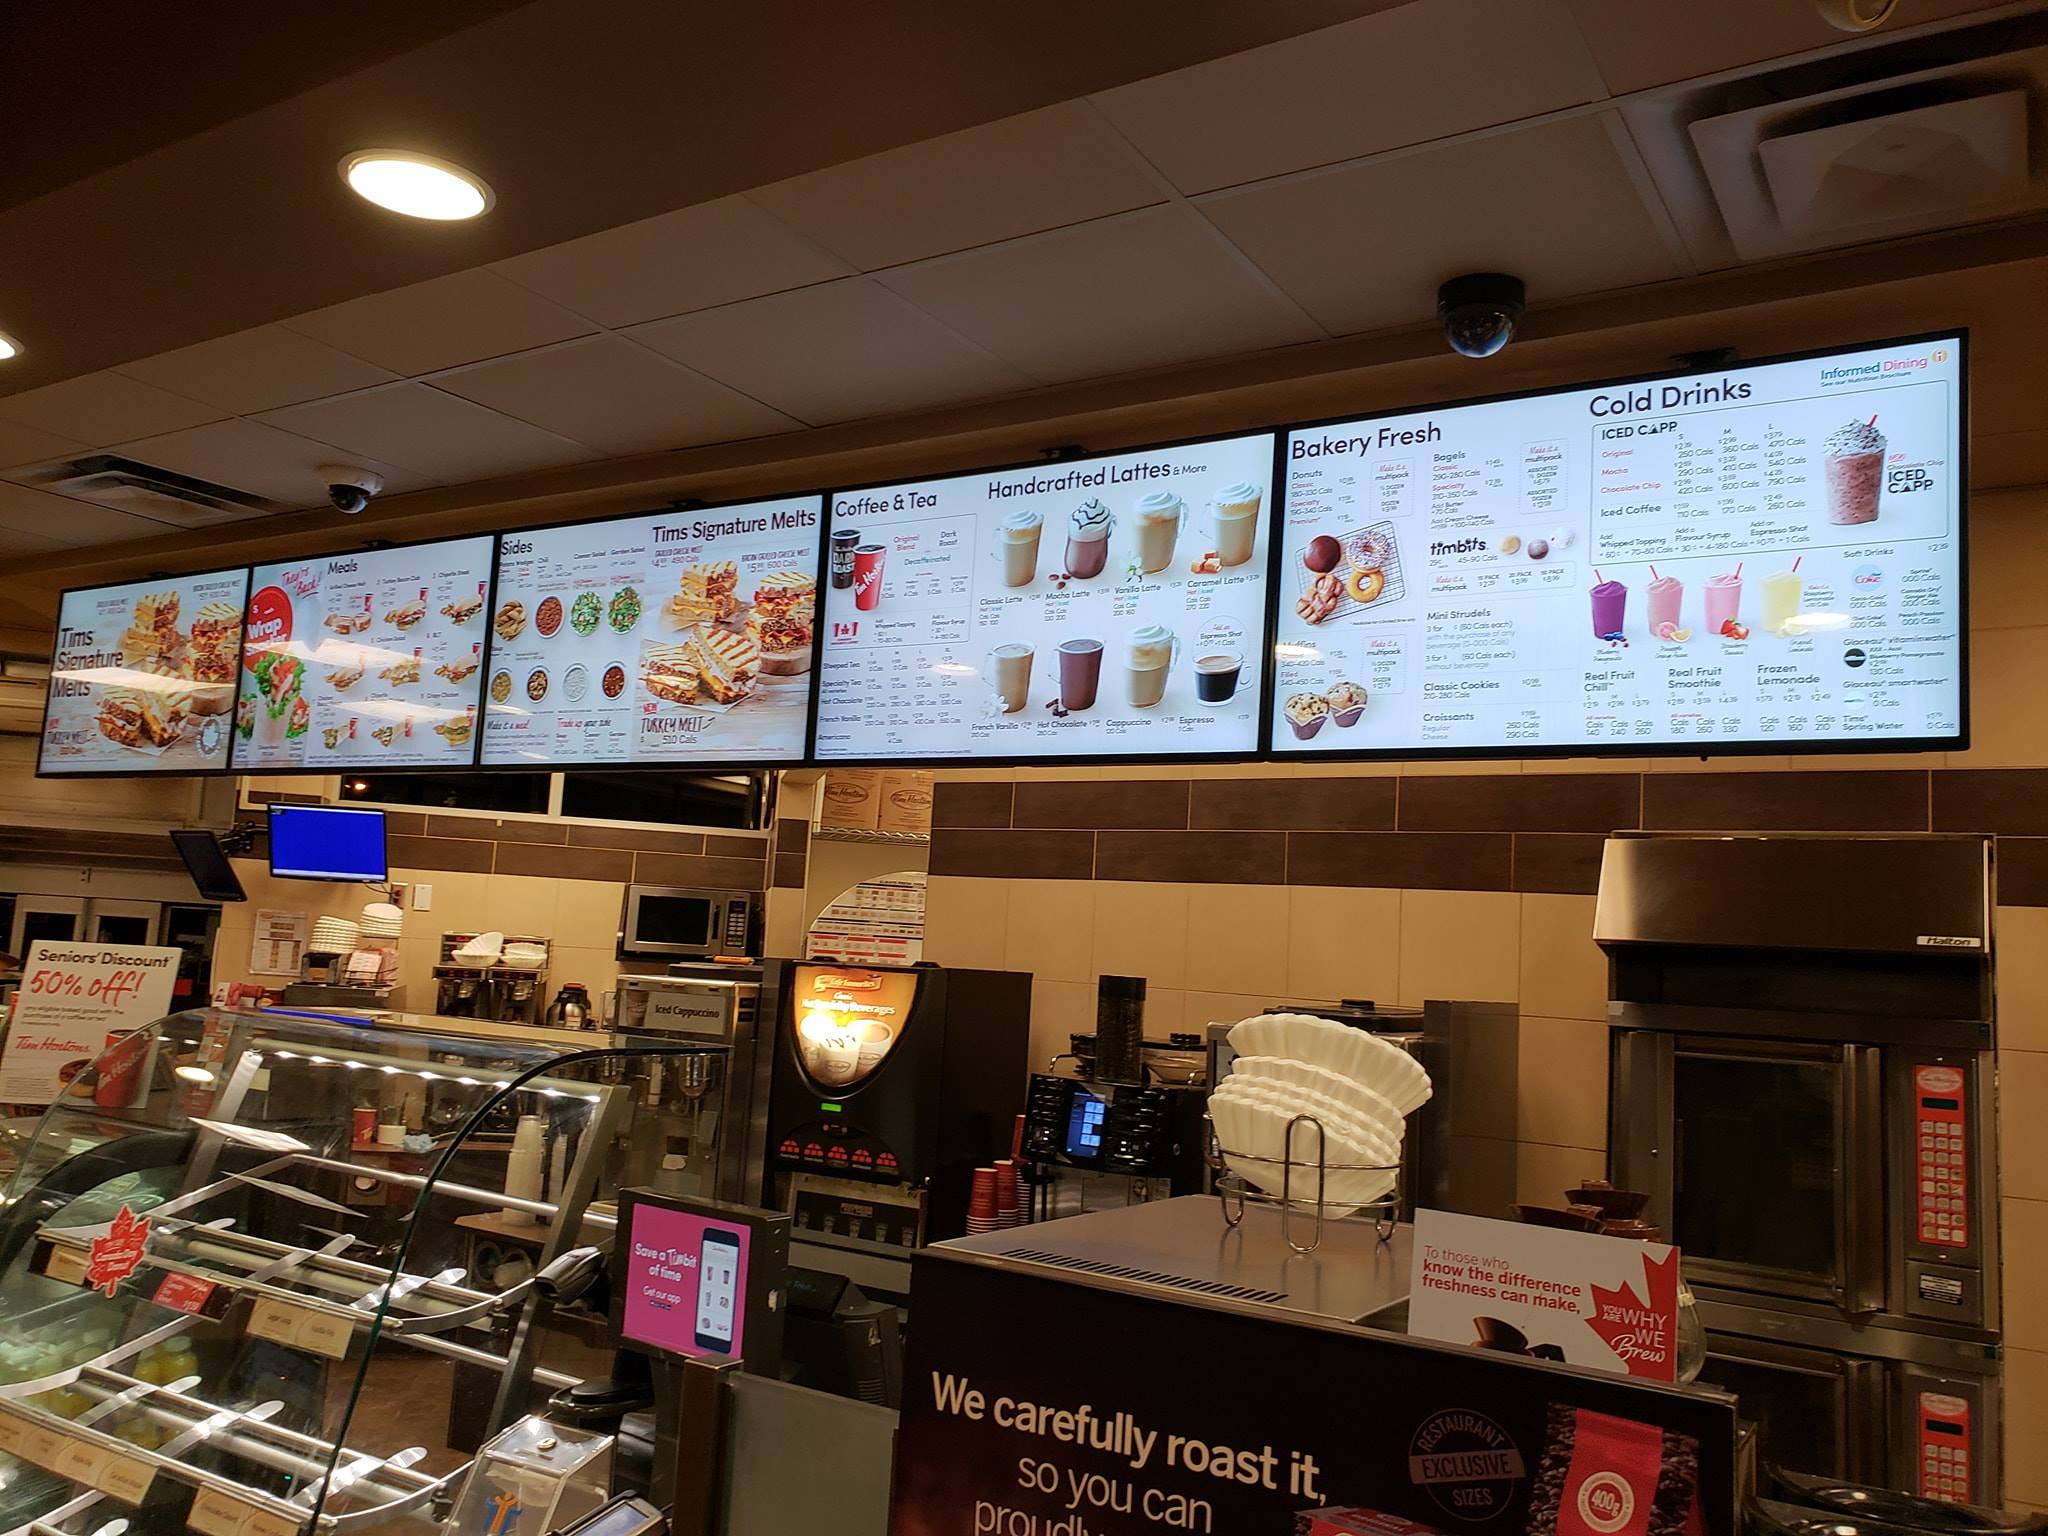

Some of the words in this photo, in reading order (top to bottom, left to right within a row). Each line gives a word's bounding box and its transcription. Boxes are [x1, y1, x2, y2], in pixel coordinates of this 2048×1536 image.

[1821, 362, 1880, 380] Informed
[1883, 358, 1928, 372] Dining
[1590, 389, 1652, 417] Cold
[1662, 378, 1753, 409] Drinks
[1602, 427, 1634, 440] ICED
[1292, 436, 1371, 460] Bakery
[1378, 422, 1441, 448] Fresh
[1433, 451, 1466, 462] Bagels
[1525, 453, 1562, 463] multipack
[1601, 449, 1633, 459] Original
[1433, 464, 1459, 472] Classic
[1601, 468, 1628, 476] Mocha
[1292, 469, 1323, 480] Donuts
[1375, 471, 1409, 481] multipack
[1888, 469, 1926, 483] ICED
[988, 466, 1106, 500] Handcrafted
[1111, 462, 1170, 485] Lattes
[1173, 467, 1180, 476] &
[1182, 464, 1207, 475] More
[1291, 480, 1314, 489] Classic
[1432, 482, 1465, 492] Specialty
[1601, 484, 1640, 494] Chocolate
[1641, 482, 1661, 490] Chip
[835, 497, 889, 518] Coffee
[894, 494, 904, 510] &
[908, 492, 937, 509] Tea
[1600, 507, 1623, 518] Iced
[1625, 504, 1661, 515] Coffee
[652, 526, 688, 543] Tims
[692, 517, 767, 542] Signature
[771, 509, 816, 530] Melts
[1789, 525, 1808, 534] Shot
[894, 535, 920, 544] Original
[940, 531, 957, 539] Dark
[501, 539, 533, 556] Sides
[897, 543, 916, 551] Blend
[939, 539, 958, 547] Roast
[1430, 537, 1487, 556] timbits
[1600, 539, 1634, 549] Whipped
[1635, 537, 1666, 546] Topping
[1843, 550, 1863, 558] Soft
[1865, 548, 1894, 556] Drinks
[904, 555, 951, 566] Decaffeinated
[327, 559, 359, 576] Meals
[1187, 578, 1222, 589] Caramel
[1224, 576, 1246, 586] Latte
[1431, 584, 1467, 593] multipack
[1114, 585, 1140, 594] Vanilla
[1141, 584, 1161, 592] Latte
[980, 597, 1004, 606] Classic
[1005, 594, 1022, 604] Latte
[1046, 591, 1070, 601] Mocha
[1072, 590, 1090, 598] Latte
[1427, 610, 1448, 621] Mini
[1450, 608, 1491, 619] Strudels
[247, 618, 283, 640] Wrap
[1433, 624, 1443, 632] for
[61, 627, 94, 649] Tims
[1228, 630, 1243, 639] Shot
[1367, 647, 1401, 657] multipack
[57, 649, 124, 672] Signature
[823, 662, 848, 671] Steeped
[1668, 668, 1693, 677] Real
[1696, 667, 1722, 677] Fruit
[1757, 664, 1798, 674] Frozen
[1584, 671, 1608, 682] Real
[1610, 671, 1635, 680] Fruit
[1757, 674, 1821, 686] Lemonade
[822, 679, 850, 688] Specialty
[1424, 682, 1459, 692] Classic
[1462, 680, 1500, 690] Cookies
[1668, 678, 1722, 689] Smoothie
[833, 696, 863, 705] Chocolate
[1179, 716, 1215, 726] Espresso
[1423, 712, 1474, 722] Croissants
[641, 717, 677, 734] TURKEY
[679, 717, 703, 733] MELT
[971, 723, 995, 731] French
[996, 722, 1019, 730] Vanilla
[1037, 721, 1049, 729] Hot
[1050, 720, 1087, 729] Chocolate
[1106, 718, 1151, 729] Cappuccino
[1842, 723, 1874, 731] Spring
[1875, 722, 1904, 730] Water
[662, 735, 677, 745] 510
[679, 735, 698, 745] Cals
[1422, 733, 1449, 741] Cheese
[1927, 937, 1971, 946] Halton
[38, 949, 100, 963] Seniors'
[30, 970, 83, 996] 50%
[88, 970, 147, 1007] off!
[655, 1004, 672, 1015] Iced
[673, 1006, 720, 1019] Cappuccino
[16, 1036, 38, 1050] Tim
[40, 1036, 90, 1053] Hortons
[634, 1242, 658, 1260] Save
[658, 1252, 665, 1261] a
[667, 1248, 697, 1268] Timbit
[1424, 1245, 1439, 1260] To
[1442, 1248, 1478, 1266] those
[1482, 1256, 1510, 1270] who
[649, 1264, 660, 1277] of
[660, 1266, 682, 1282] time
[1423, 1259, 1464, 1278] know
[1468, 1264, 1494, 1282] the
[1498, 1270, 1582, 1297] difference
[642, 1285, 655, 1296] Get
[667, 1293, 681, 1304] app
[1422, 1274, 1496, 1299] freshness
[1500, 1288, 1529, 1304] can
[1532, 1292, 1581, 1315] make,
[1602, 1304, 1622, 1316] YOU
[1602, 1313, 1622, 1323] ARE
[1622, 1308, 1668, 1329] WHY
[1636, 1328, 1666, 1348] WE
[1610, 1334, 1666, 1364] Brew
[932, 1370, 986, 1420] We
[993, 1397, 1157, 1469] carefully
[1167, 1433, 1278, 1490] roast
[1290, 1450, 1327, 1506] it,
[1417, 1415, 1505, 1452] RESTAURANT
[1421, 1453, 1513, 1480] EXCLUSIVE
[1018, 1456, 1060, 1494] so
[1065, 1468, 1133, 1514] you
[1143, 1487, 1212, 1533] can
[1452, 1488, 1493, 1506] SIZES
[975, 1500, 1104, 1536] proud
